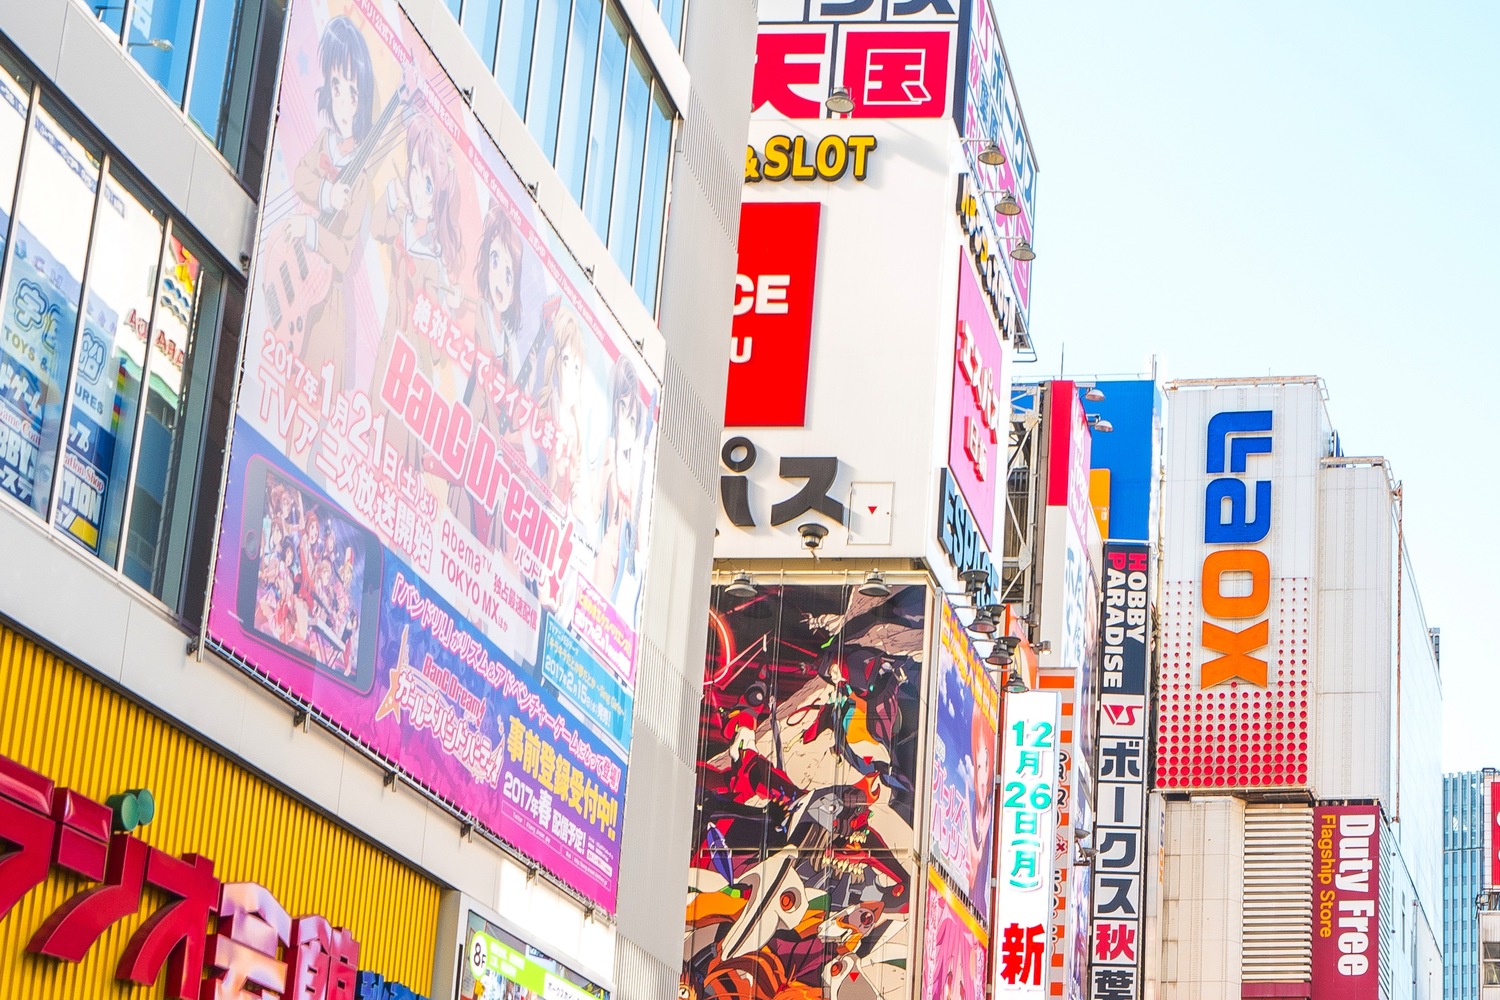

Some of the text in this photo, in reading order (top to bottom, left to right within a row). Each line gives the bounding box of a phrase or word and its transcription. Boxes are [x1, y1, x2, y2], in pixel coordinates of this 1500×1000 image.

[439, 549, 481, 605] TOKYO
[481, 590, 499, 624] MX
[1103, 552, 1128, 689] PARADISE
[1126, 552, 1148, 645] HOBBY
[502, 771, 553, 830] 2017年春
[506, 715, 619, 842] 事前登録受付中!!
[1318, 814, 1336, 938] Flagship Store
[1335, 814, 1376, 977] Duty Free
